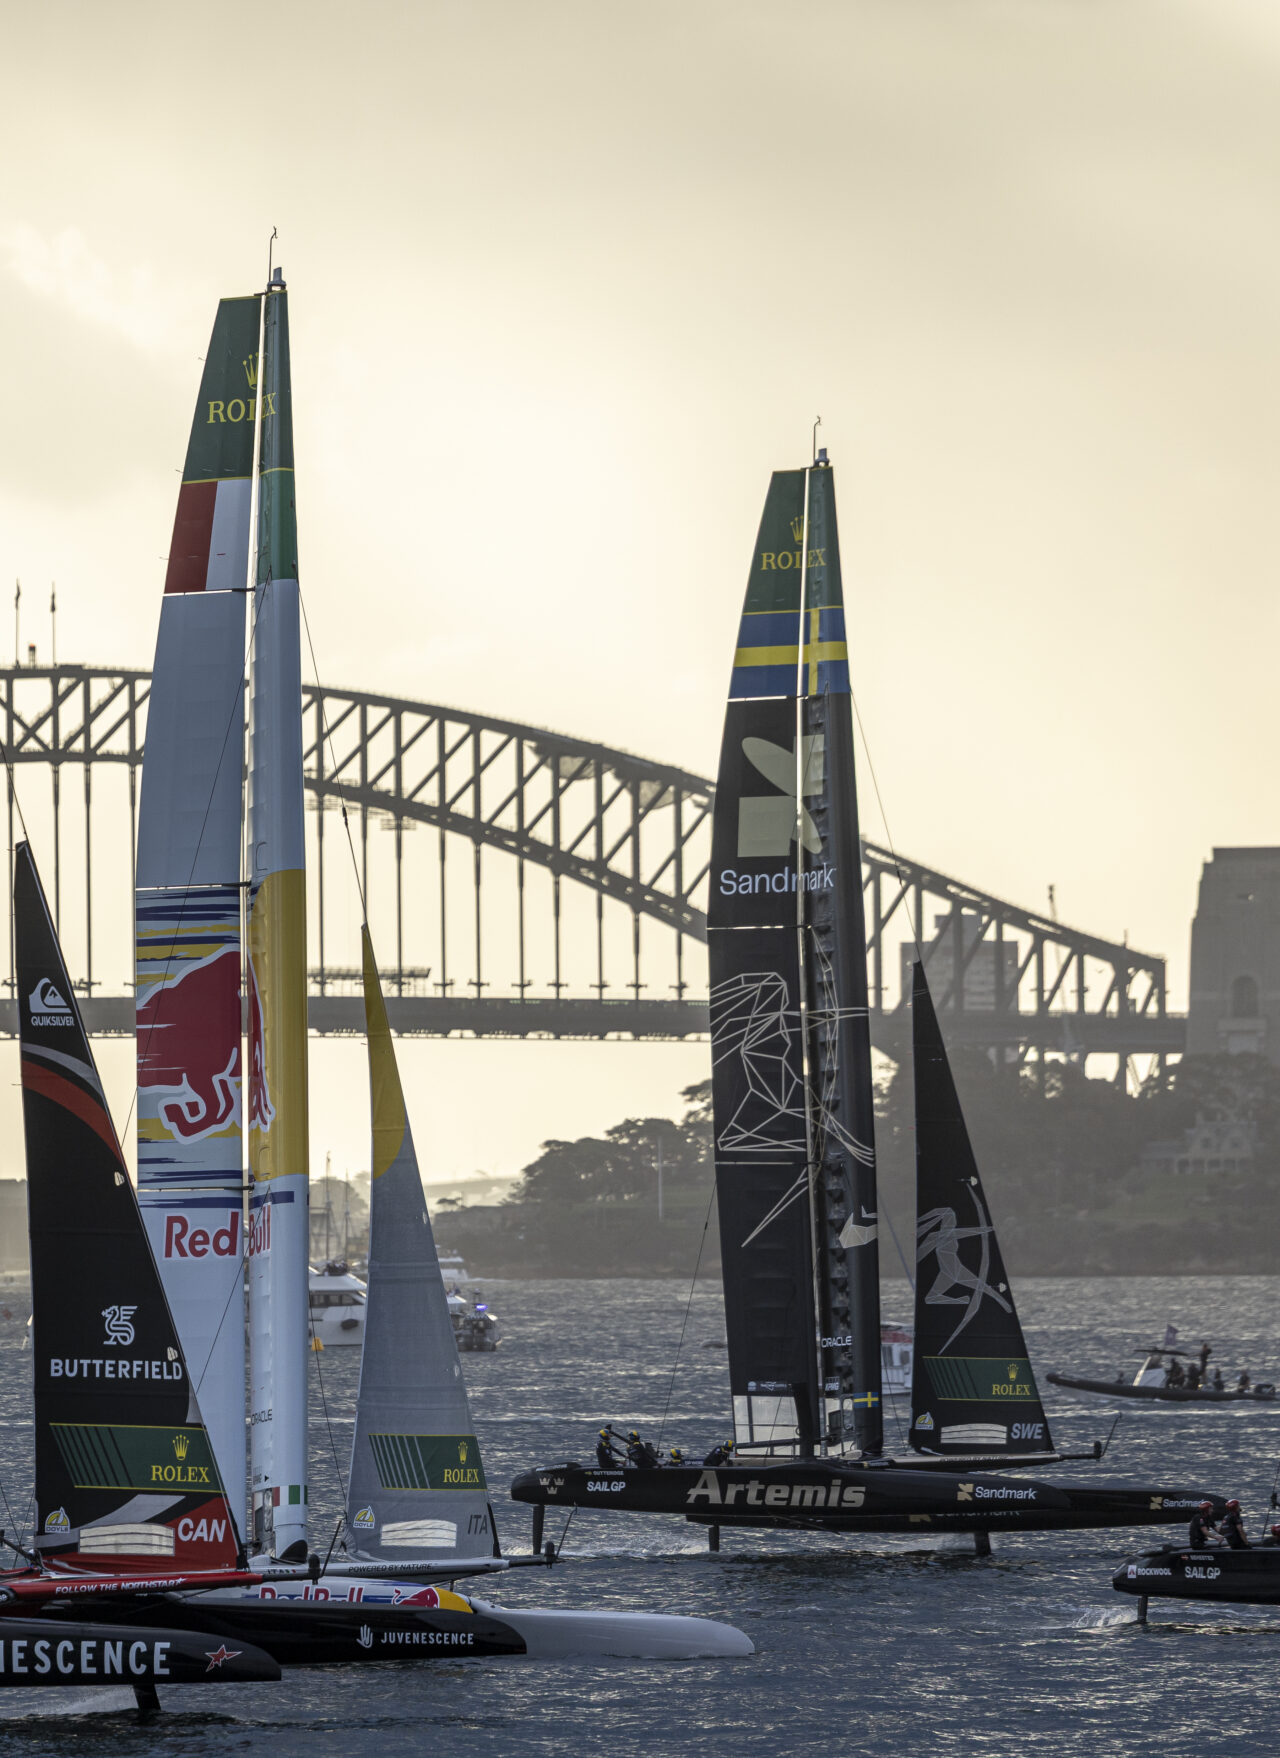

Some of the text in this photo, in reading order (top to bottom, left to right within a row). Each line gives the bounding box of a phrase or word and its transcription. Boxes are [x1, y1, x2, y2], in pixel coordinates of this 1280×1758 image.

[760, 548, 827, 570] ROLEX
[720, 863, 835, 895] Sandmark
[31, 1016, 74, 1026] QUIKSILVER
[164, 1204, 270, 1258] Red Bull
[822, 1335, 852, 1348] ORACLE
[50, 1359, 183, 1380] BUTTERFIELD
[992, 1384, 1031, 1395] ROLEX
[251, 1409, 272, 1426] ORACLE
[1011, 1423, 1043, 1439] SWE
[151, 1465, 210, 1483] ROLEX
[443, 1469, 479, 1483] ROLEX
[587, 1481, 626, 1492] SAILGP
[687, 1470, 866, 1508] Artemis
[975, 1486, 1037, 1499] Sandmark
[1163, 1499, 1204, 1508] Sandmar
[177, 1518, 226, 1542] CAN
[467, 1515, 488, 1535] ITA
[349, 1566, 386, 1574] POWERED
[400, 1563, 432, 1571] NATURE
[55, 1580, 175, 1595] FOLLOW THE NORTHSTAR
[381, 1632, 474, 1645] JUVENESCENCE
